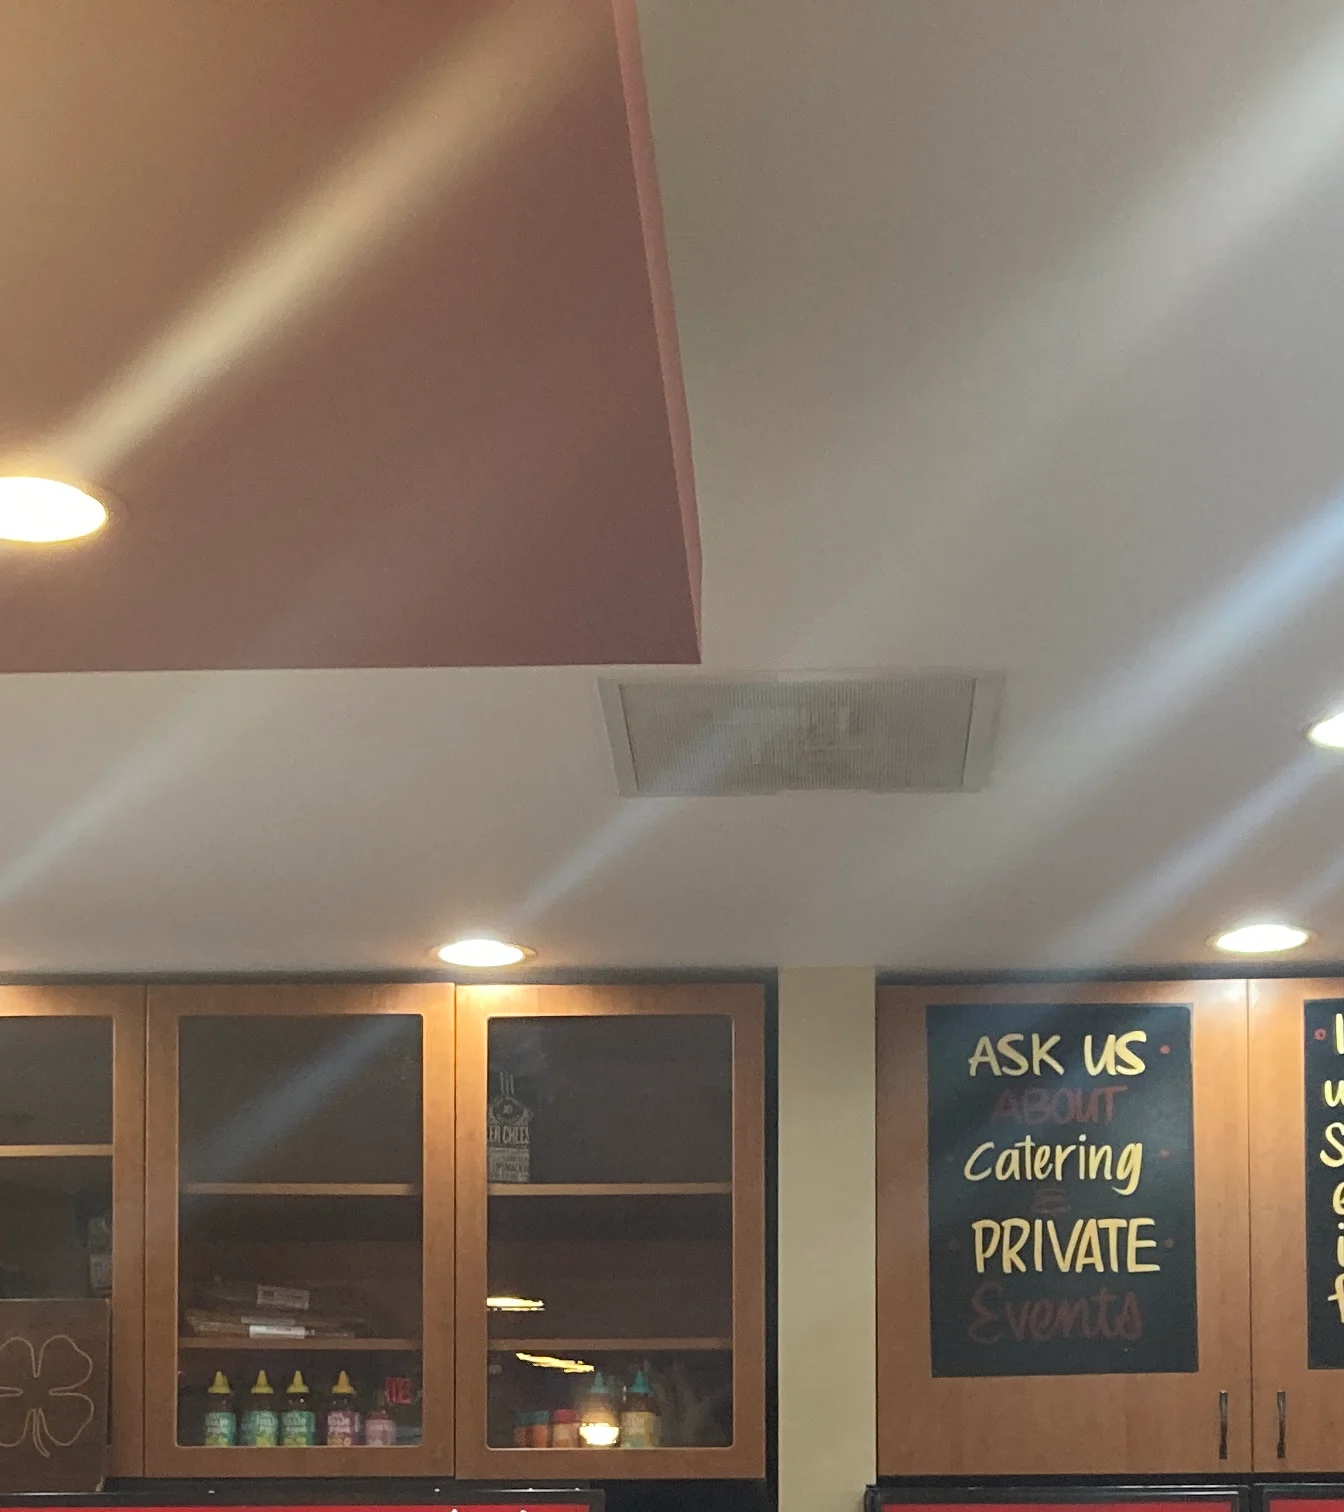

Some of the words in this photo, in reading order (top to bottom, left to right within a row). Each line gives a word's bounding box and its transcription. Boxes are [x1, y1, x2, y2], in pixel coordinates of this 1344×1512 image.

[968, 1033, 1064, 1076] ASK
[1084, 1030, 1147, 1076] US
[1336, 1013, 1344, 1055] I
[989, 1084, 1129, 1125] ABOUT
[963, 1134, 1142, 1195] Catering
[971, 1217, 1161, 1273] PRIVATE
[967, 1281, 1144, 1344] Events
